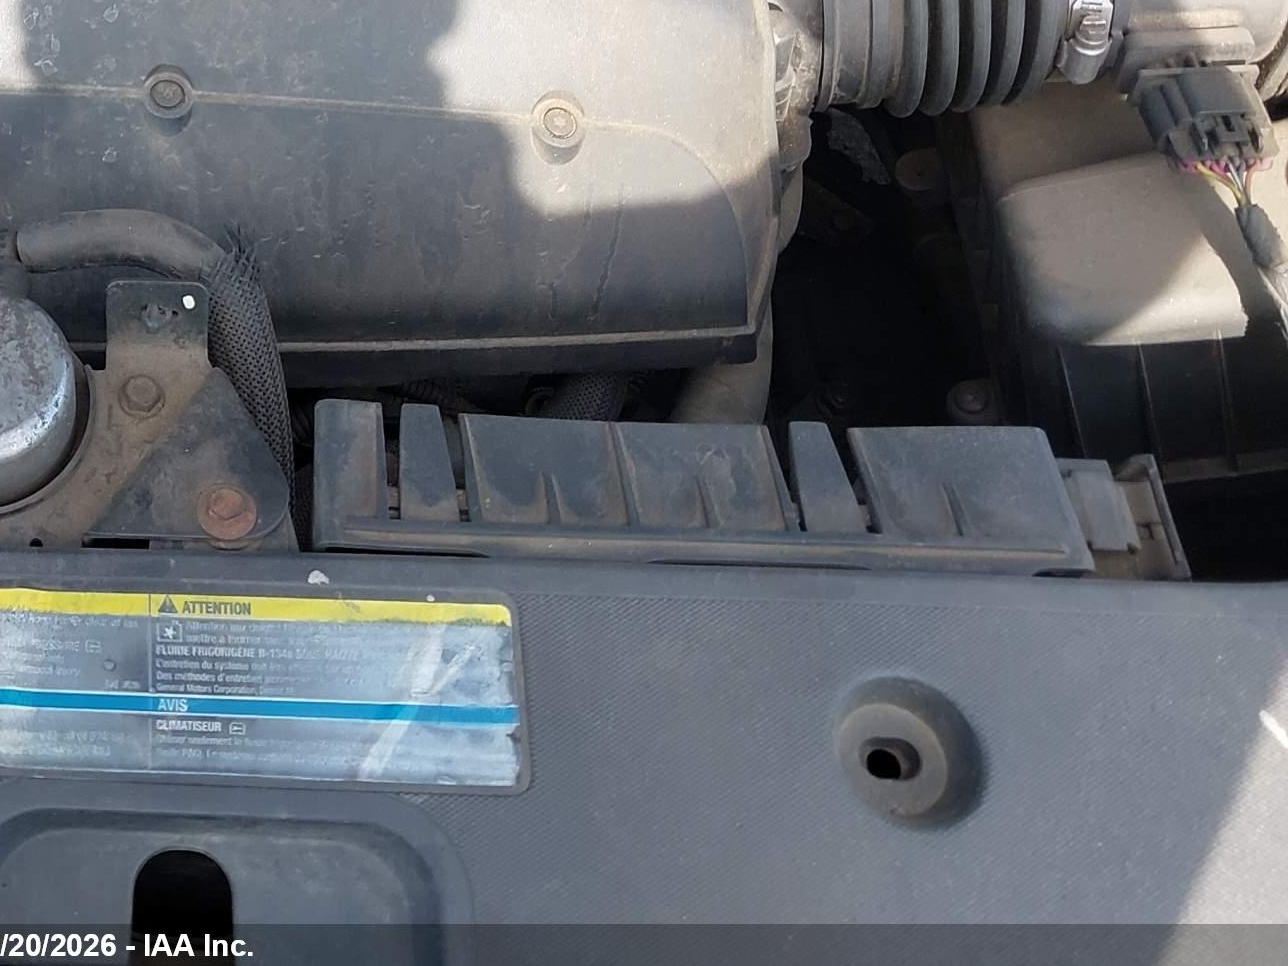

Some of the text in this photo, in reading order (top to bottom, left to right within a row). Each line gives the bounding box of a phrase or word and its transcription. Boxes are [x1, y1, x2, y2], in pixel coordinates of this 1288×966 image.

[182, 600, 251, 615] ATTENTION
[156, 645, 190, 656] FLUIDE
[158, 698, 188, 712] AVIS
[156, 720, 222, 732] CLIMATISEUR
